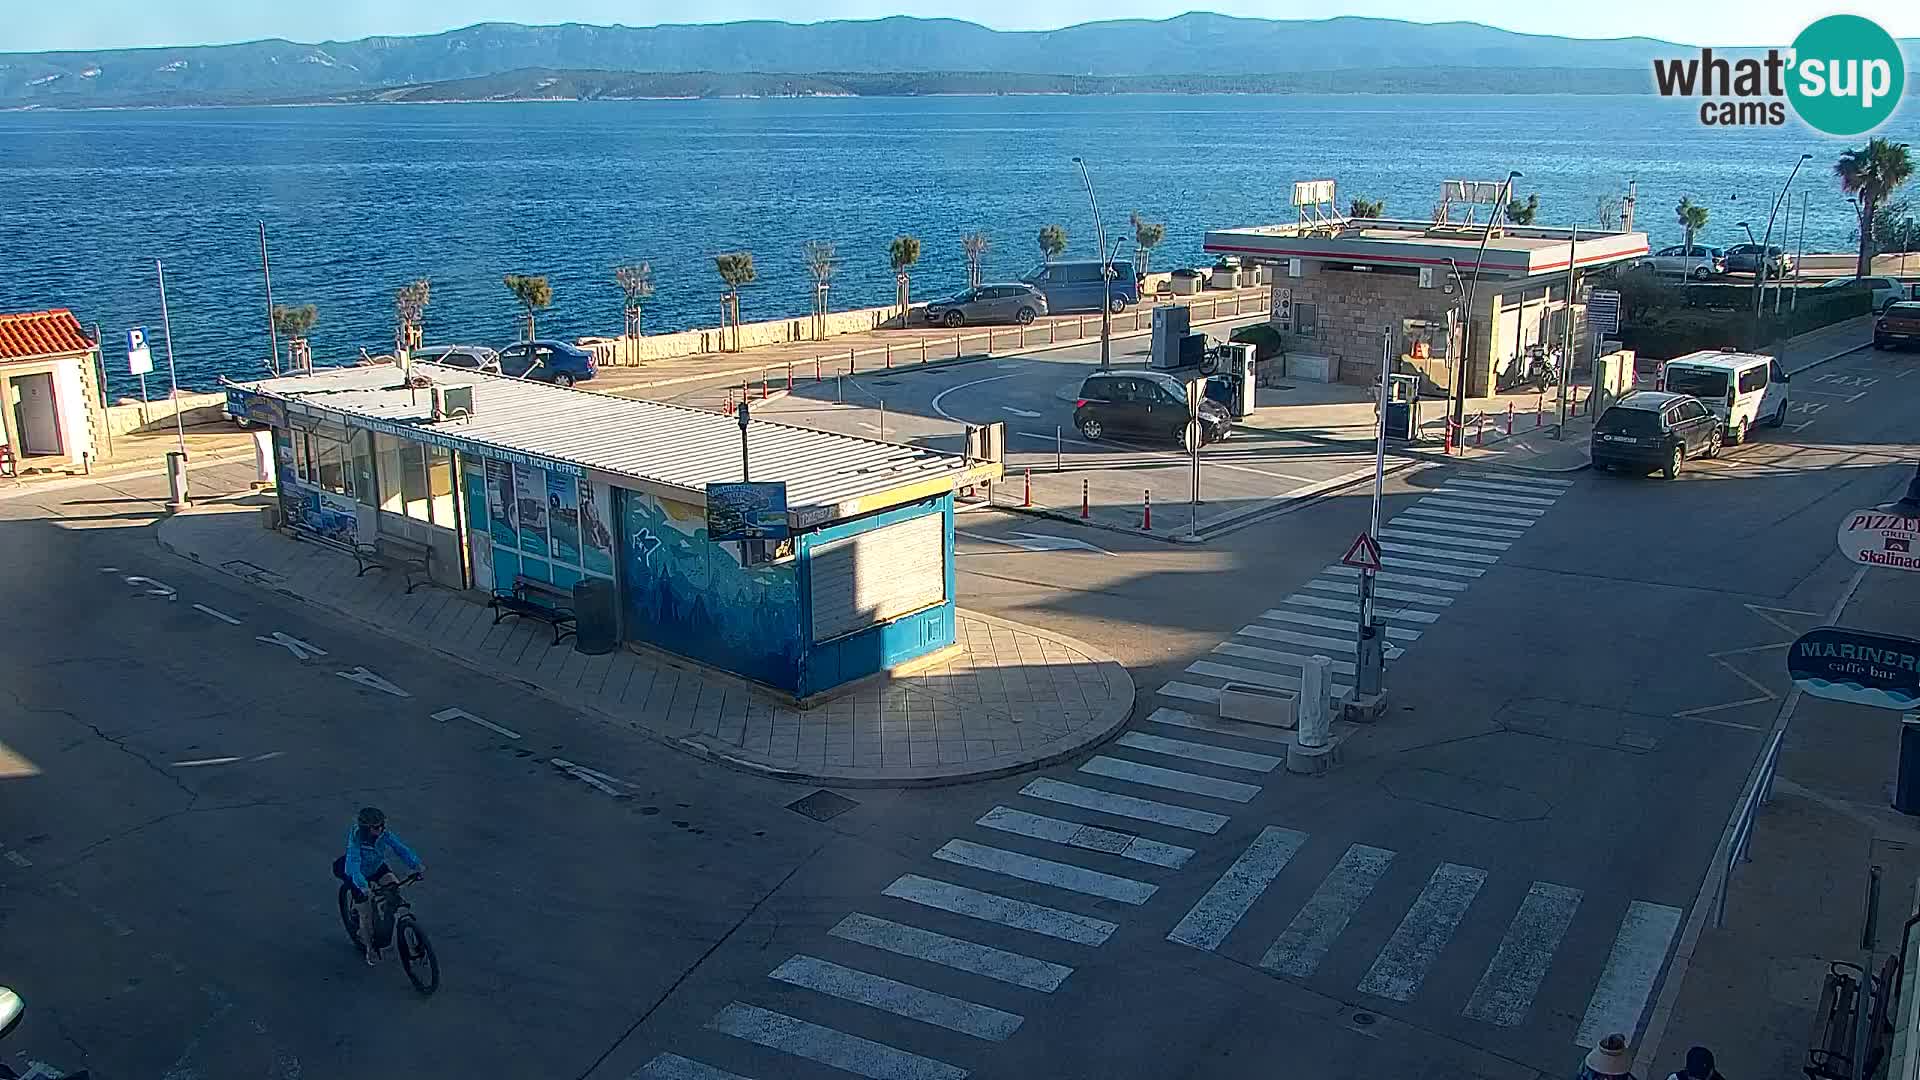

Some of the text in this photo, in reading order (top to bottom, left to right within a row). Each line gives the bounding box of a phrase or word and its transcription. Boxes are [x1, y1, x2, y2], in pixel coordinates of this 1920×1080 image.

[130, 330, 144, 350] P
[1814, 374, 1880, 387] TAXI
[480, 446, 494, 457] BUS
[495, 450, 526, 465] STATION
[530, 457, 555, 470] TICKET
[557, 463, 583, 476] OFFICE
[1848, 515, 1920, 533] PIZZE
[1881, 530, 1913, 540] GRILL
[1800, 642, 1920, 673] MARINER
[1870, 665, 1896, 679] bar
